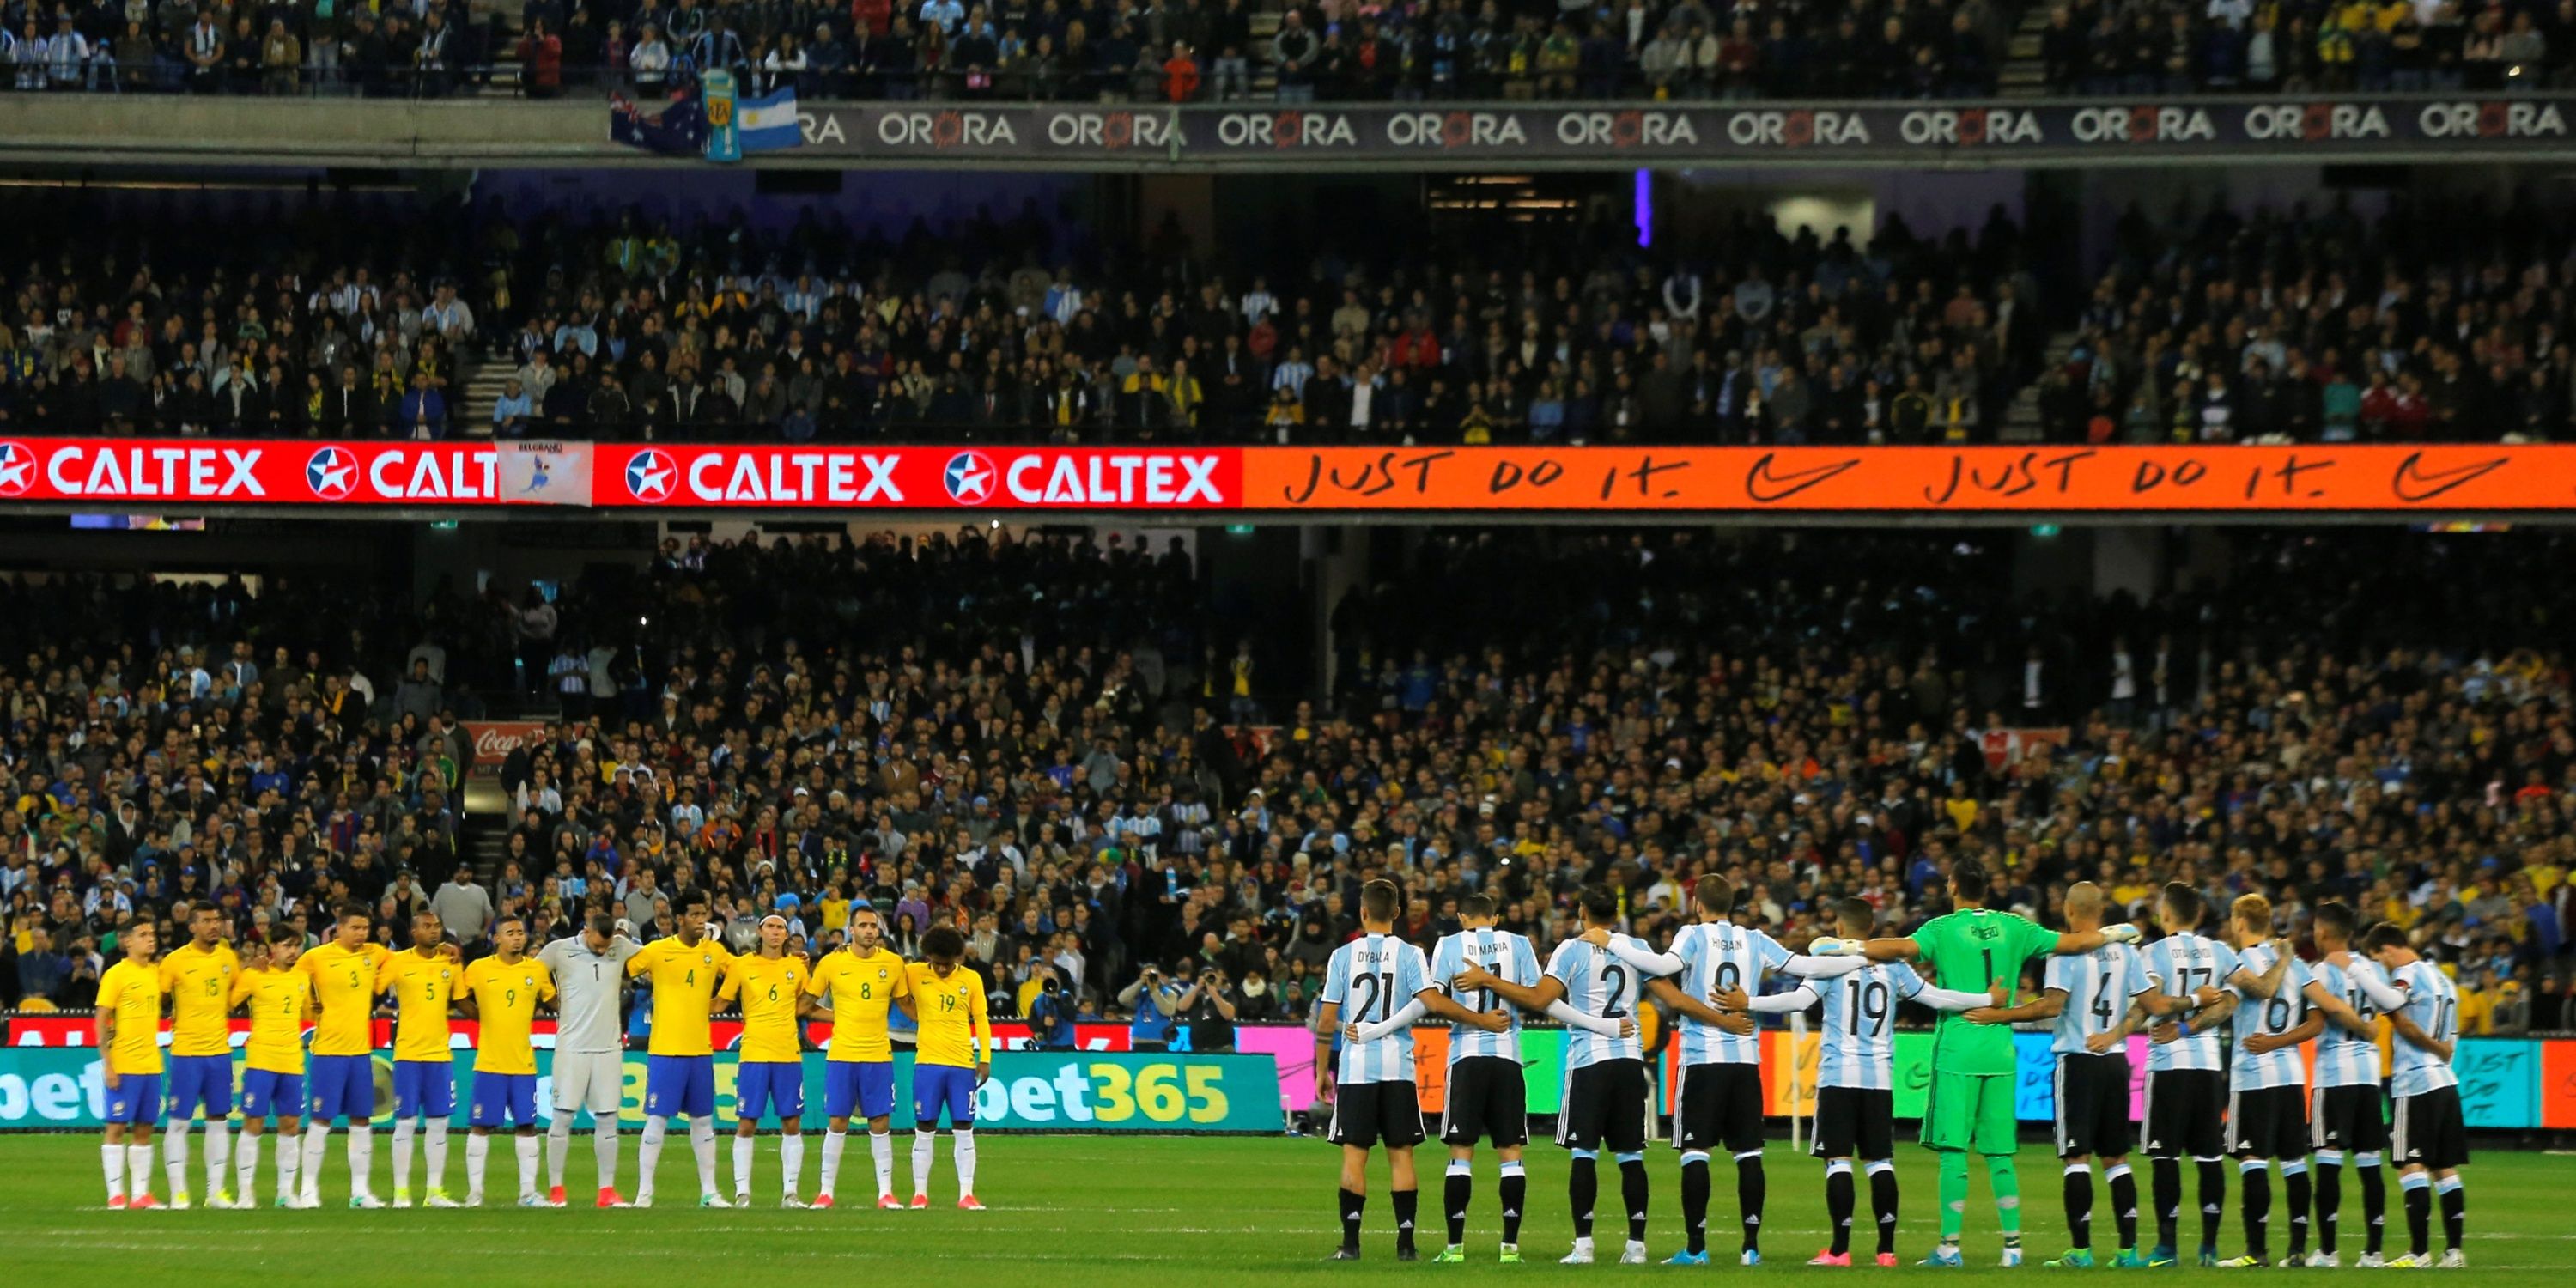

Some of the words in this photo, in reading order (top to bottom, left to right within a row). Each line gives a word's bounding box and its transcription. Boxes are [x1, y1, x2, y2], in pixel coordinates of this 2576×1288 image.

[878, 112, 1017, 146] ORORA
[1048, 112, 1186, 146] ORORA
[1218, 112, 1356, 147] ORORA
[1387, 112, 1525, 146] ORORA
[1557, 112, 1696, 146] ORORA
[1728, 111, 1869, 145] ORORA
[1899, 110, 2042, 144] ORORA
[2072, 107, 2214, 143] ORORA
[2244, 104, 2390, 140] ORORA
[2419, 102, 2567, 138] ORORA
[48, 448, 265, 496] CALTEX
[689, 453, 904, 501] CALTEX
[1007, 455, 1224, 502] CALTEX
[1284, 452, 1455, 503] JUST
[1490, 459, 1563, 494] DO
[1924, 451, 2096, 504] JUST
[2131, 459, 2207, 494] DO
[1358, 951, 1389, 963] DYBALA
[1467, 945, 1477, 956] DI
[1479, 942, 1509, 956] MARIA
[349, 971, 360, 988] 3
[592, 963, 600, 981] 1
[684, 969, 695, 987] 4
[1981, 948, 1993, 991] 1
[204, 977, 218, 997] 15
[425, 982, 434, 1001] 5
[505, 989, 515, 1008] 9
[768, 983, 778, 1001] 6
[860, 982, 871, 1000] 8
[939, 993, 956, 1013] 19
[1352, 972, 1394, 1023] 21
[1600, 964, 1627, 1018] 2
[2091, 972, 2113, 1029] 4
[2177, 968, 2212, 1022] 17
[283, 996, 293, 1013] 2
[1848, 980, 1888, 1037] 19
[975, 1062, 1230, 1123] bet365
